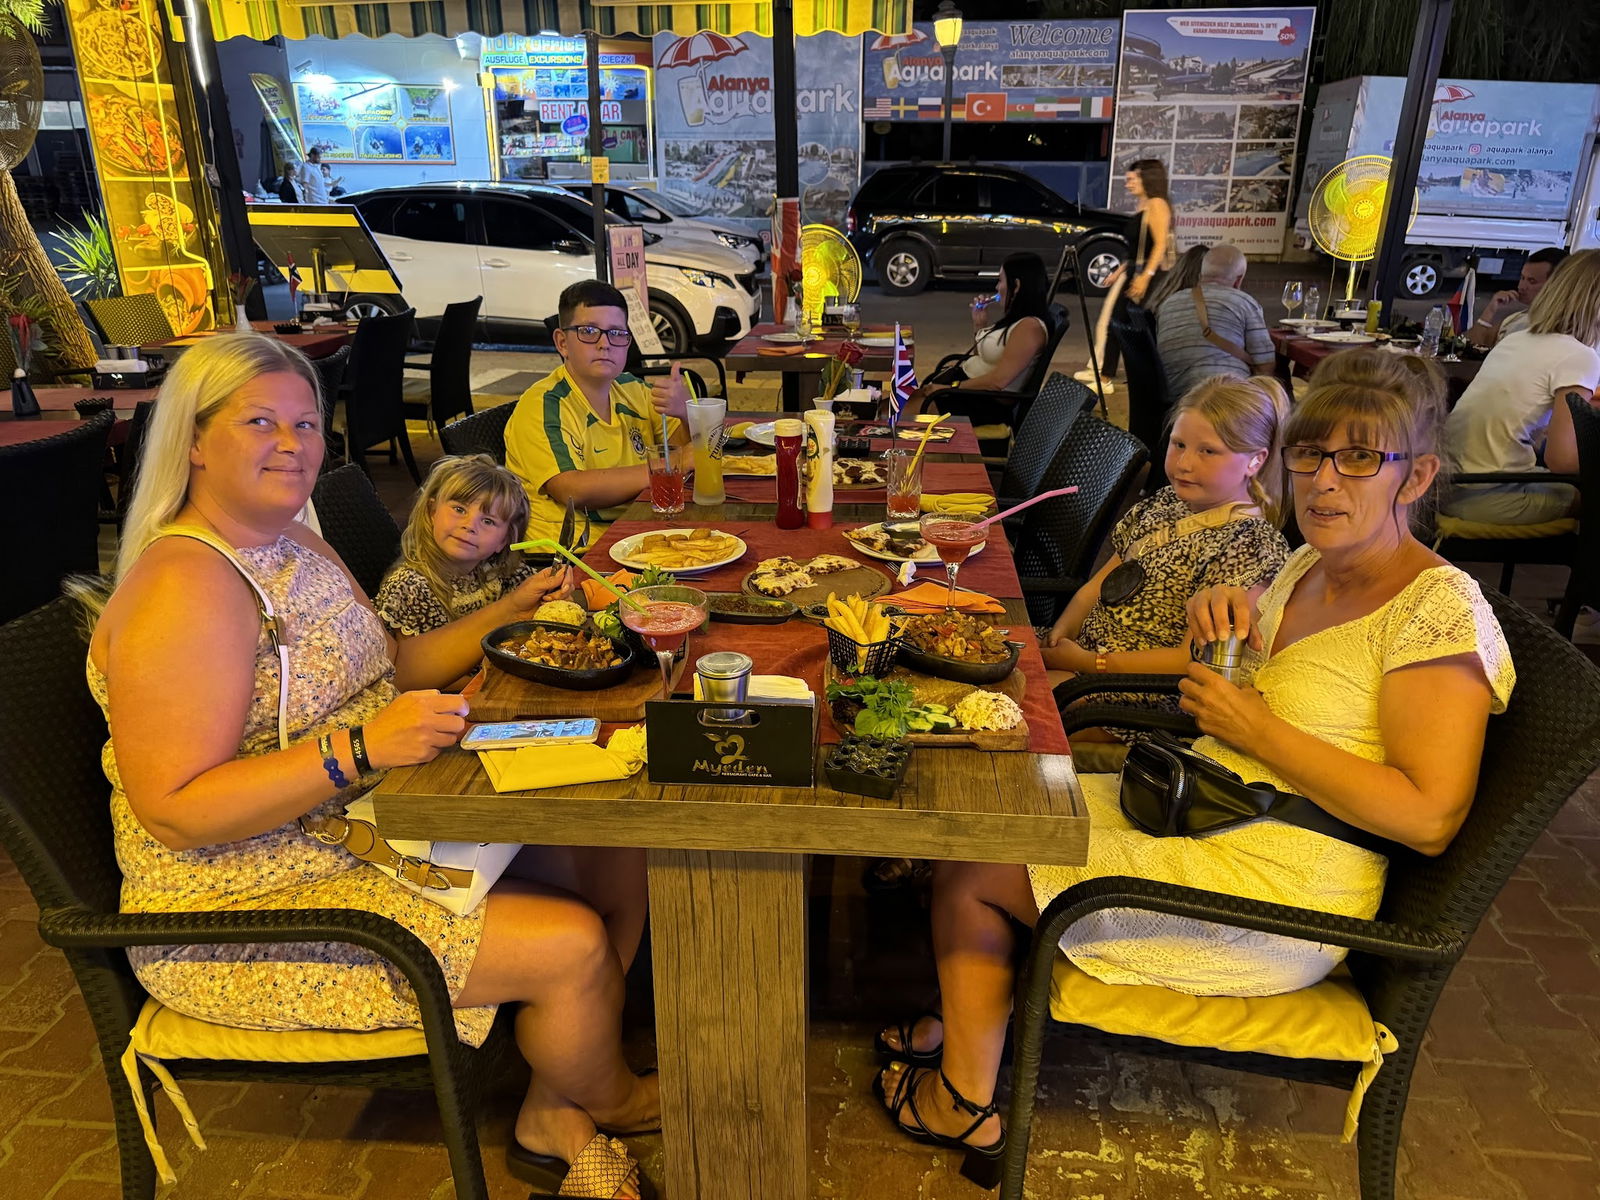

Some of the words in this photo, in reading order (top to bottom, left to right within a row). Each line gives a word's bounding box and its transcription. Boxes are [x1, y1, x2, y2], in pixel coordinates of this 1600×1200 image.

[1009, 23, 1113, 46] Welcome
[1280, 31, 1296, 40] 50%
[529, 55, 583, 64] EXCURSIONS
[599, 55, 634, 64] CIECZKI
[707, 75, 770, 95] Alanya
[541, 104, 574, 119] RENT
[602, 103, 620, 119] AR
[1441, 111, 1486, 123] Alanya
[1422, 155, 1515, 166] lanyaaquapark.com
[626, 252, 639, 269] DAY
